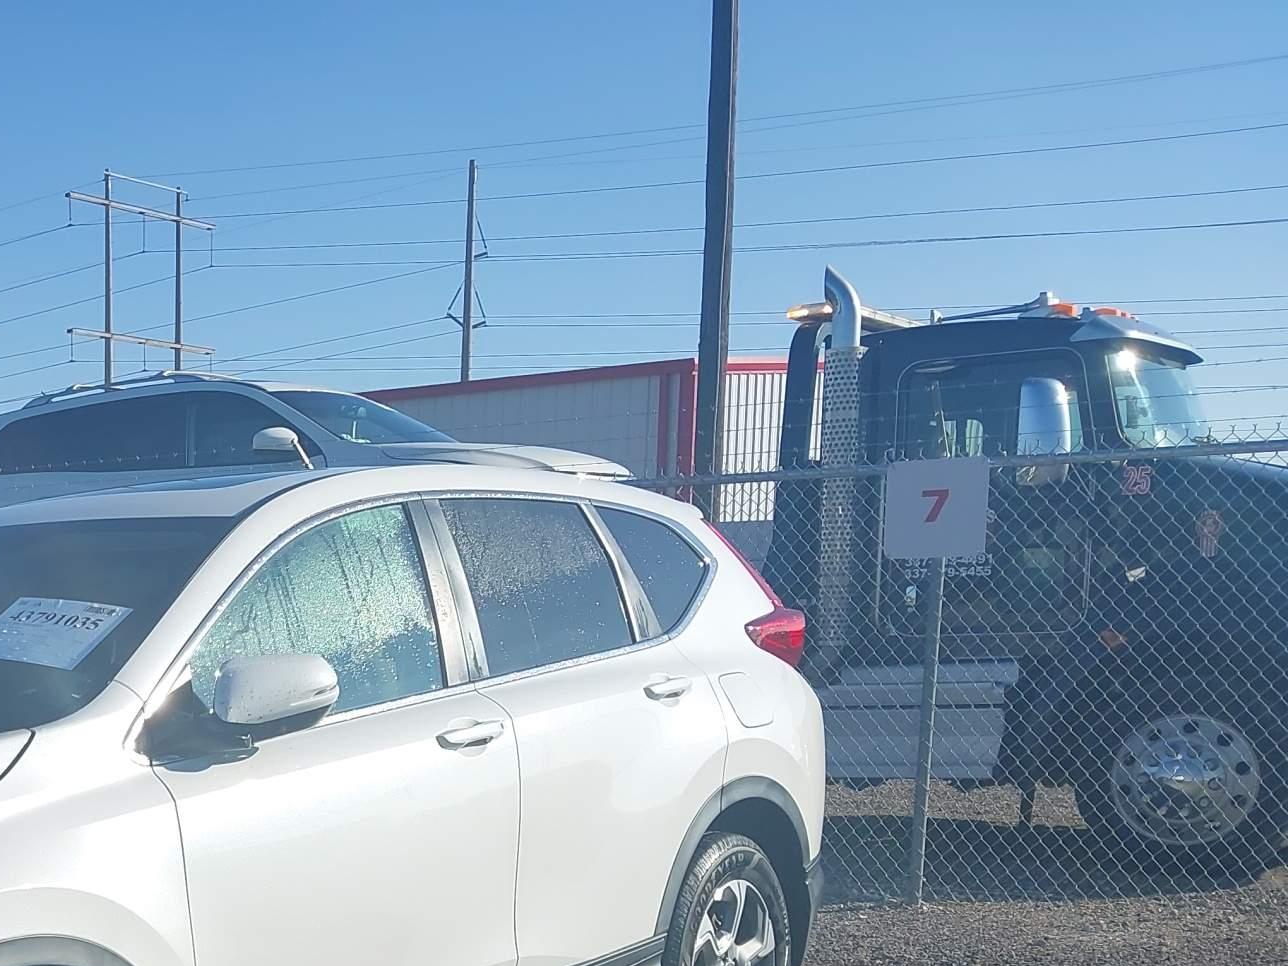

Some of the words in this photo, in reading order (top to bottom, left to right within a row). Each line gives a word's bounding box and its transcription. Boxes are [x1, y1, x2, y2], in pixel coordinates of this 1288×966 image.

[1121, 464, 1152, 496] 25
[920, 488, 950, 523] 7
[9, 609, 105, 631] 43791035
